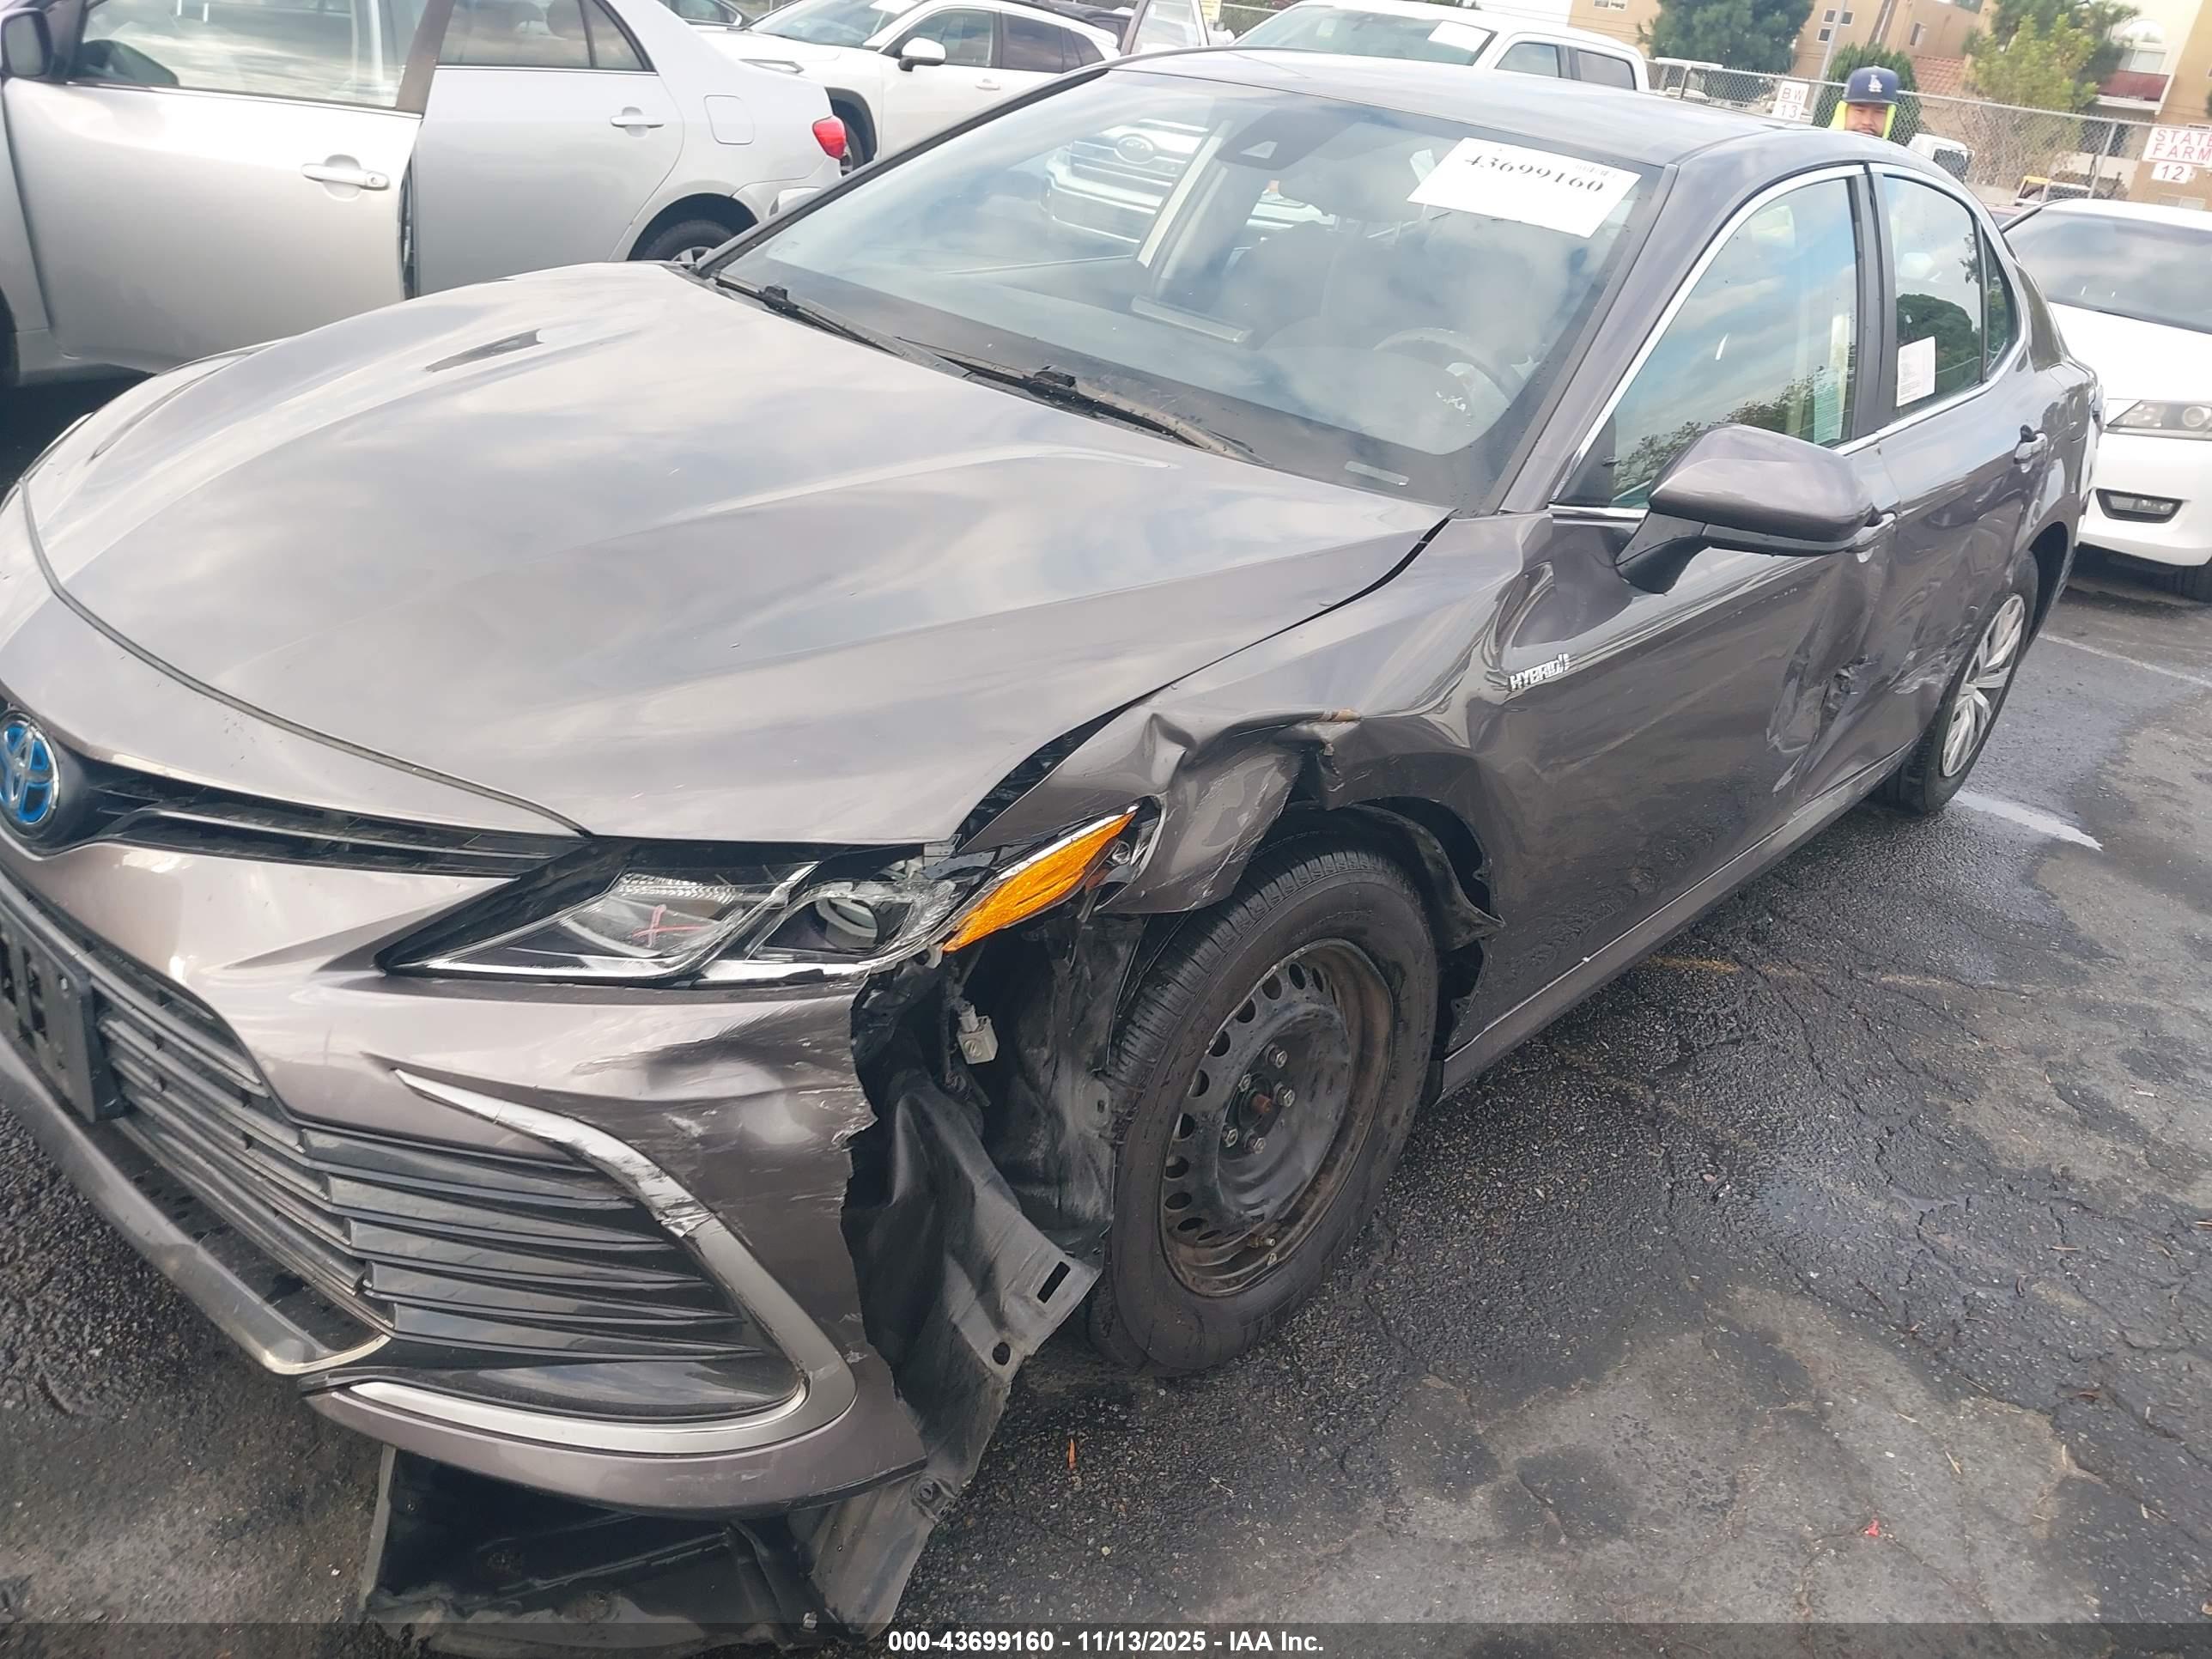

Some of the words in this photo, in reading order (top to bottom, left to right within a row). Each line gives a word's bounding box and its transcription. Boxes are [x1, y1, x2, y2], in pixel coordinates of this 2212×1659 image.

[1780, 104, 1798, 118] 13
[2152, 143, 2212, 161] FARM
[1464, 155, 1604, 191] 43699160
[2161, 164, 2185, 181] 12
[1509, 654, 1566, 690] HYBRID
